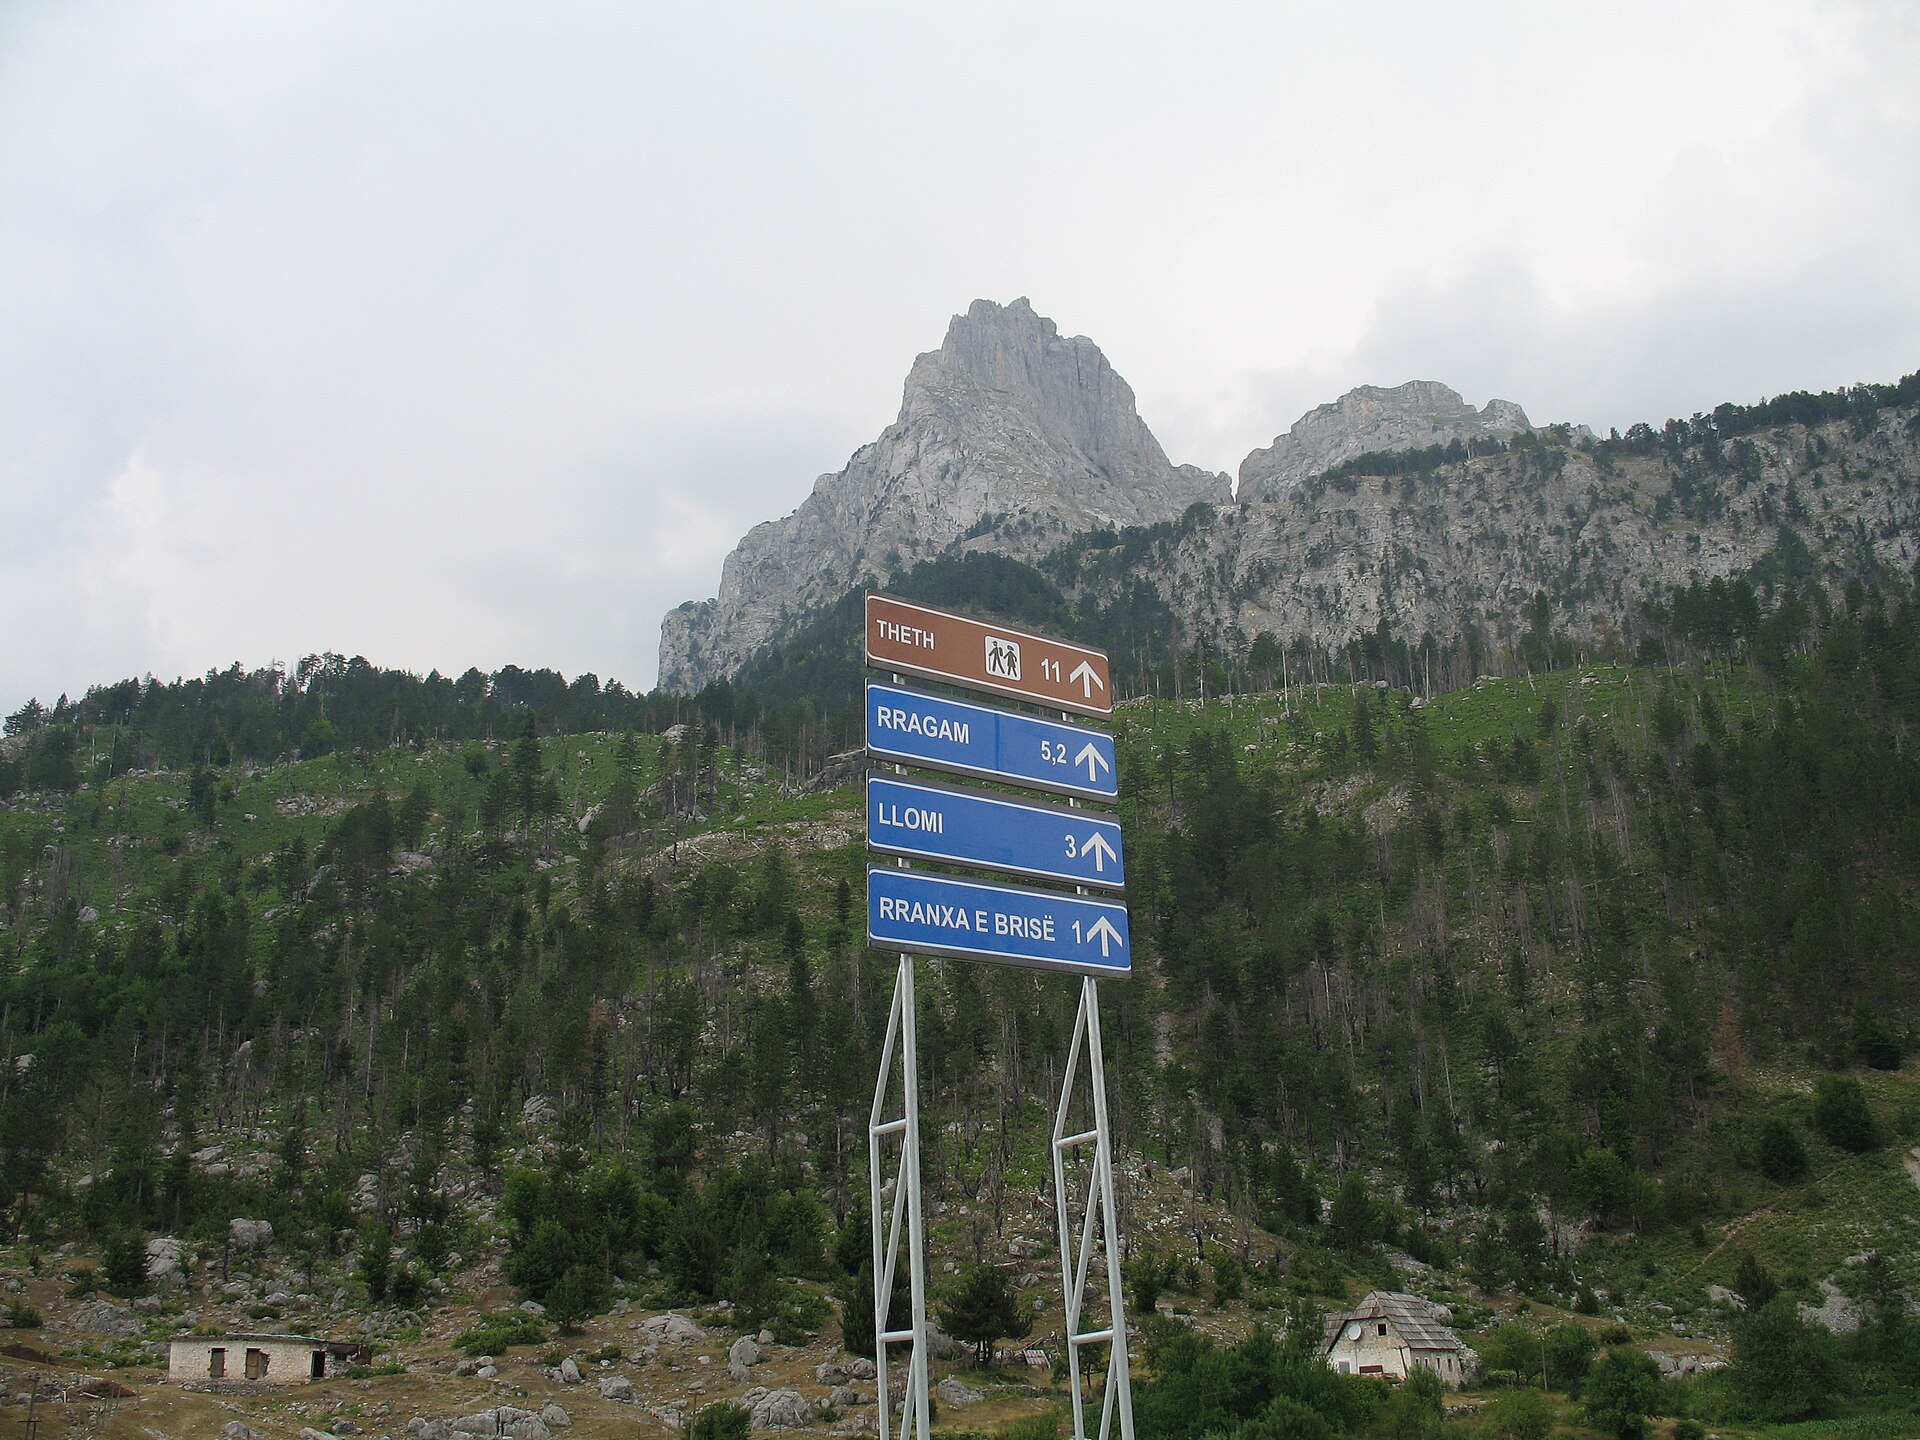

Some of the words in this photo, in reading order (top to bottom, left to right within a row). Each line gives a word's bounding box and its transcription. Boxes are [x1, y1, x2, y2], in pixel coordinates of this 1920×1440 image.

[876, 619, 935, 650] THETH
[1040, 658, 1062, 683] 11
[877, 705, 969, 744] RRAGAM
[1040, 740, 1067, 766] 5,2
[878, 802, 943, 834] LLOMI
[1064, 834, 1077, 859] 3
[879, 896, 970, 931] RRANXA
[975, 910, 989, 933] E
[994, 913, 1056, 942] BRISË
[1071, 919, 1081, 944] 1
